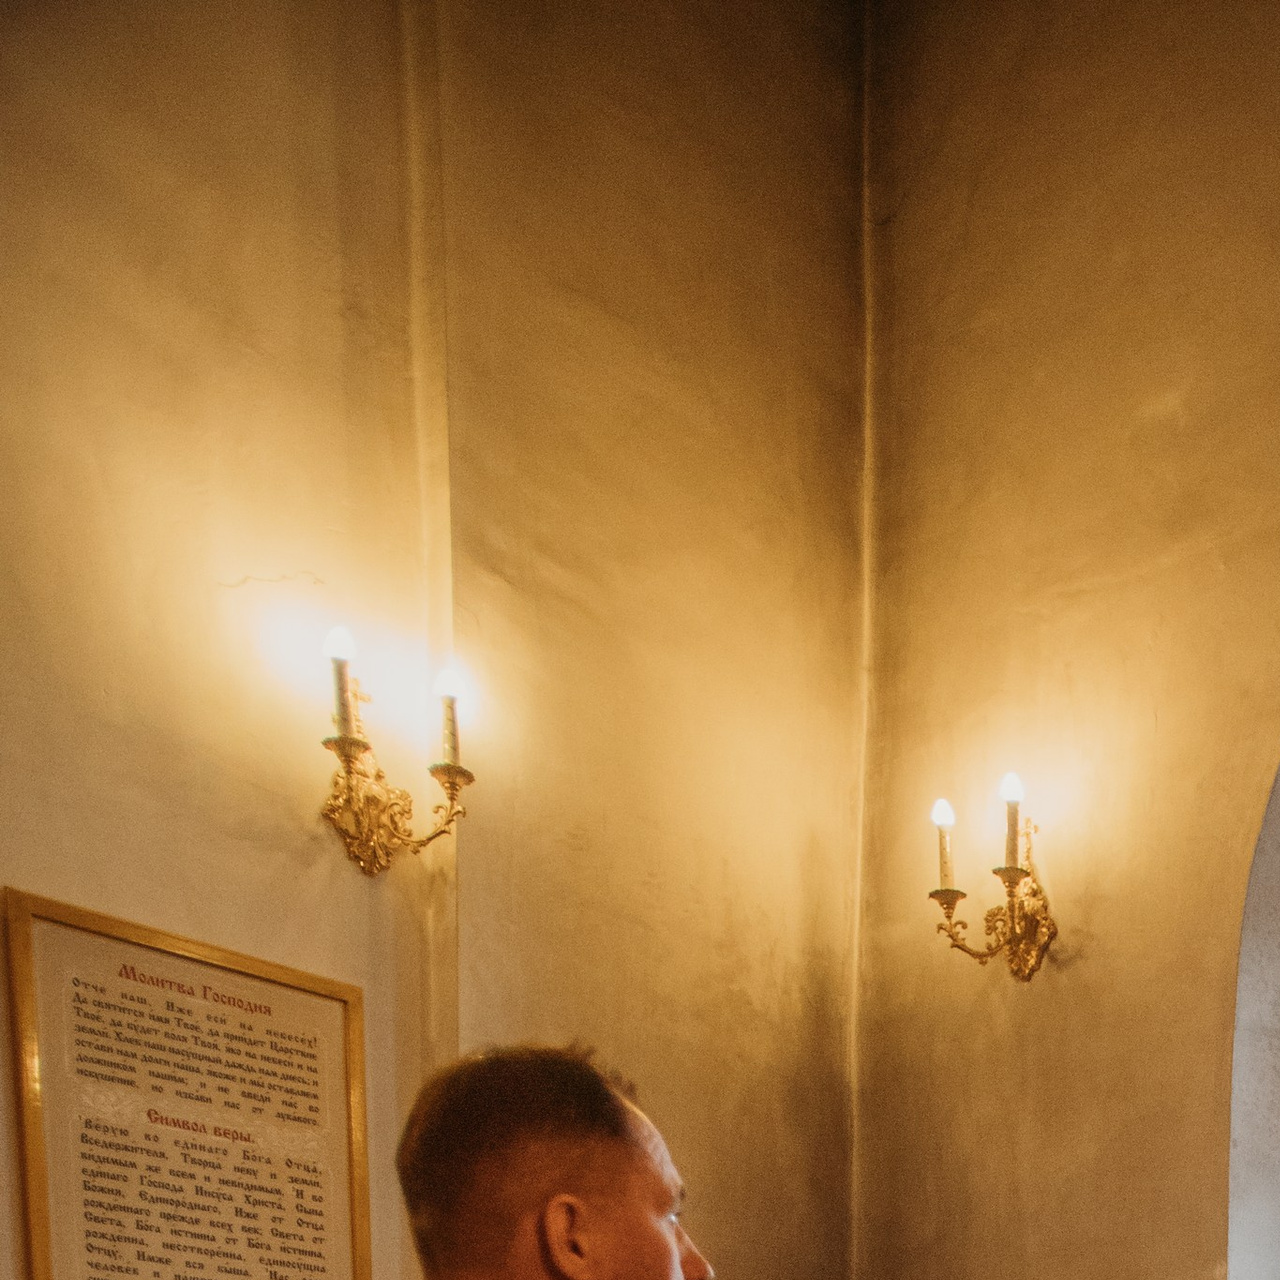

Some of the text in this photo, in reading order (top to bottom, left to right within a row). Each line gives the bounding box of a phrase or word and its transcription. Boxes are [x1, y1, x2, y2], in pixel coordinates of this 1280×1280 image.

[118, 963, 271, 1018] Молитва Господня
[147, 1111, 254, 1149] Символ веры.
